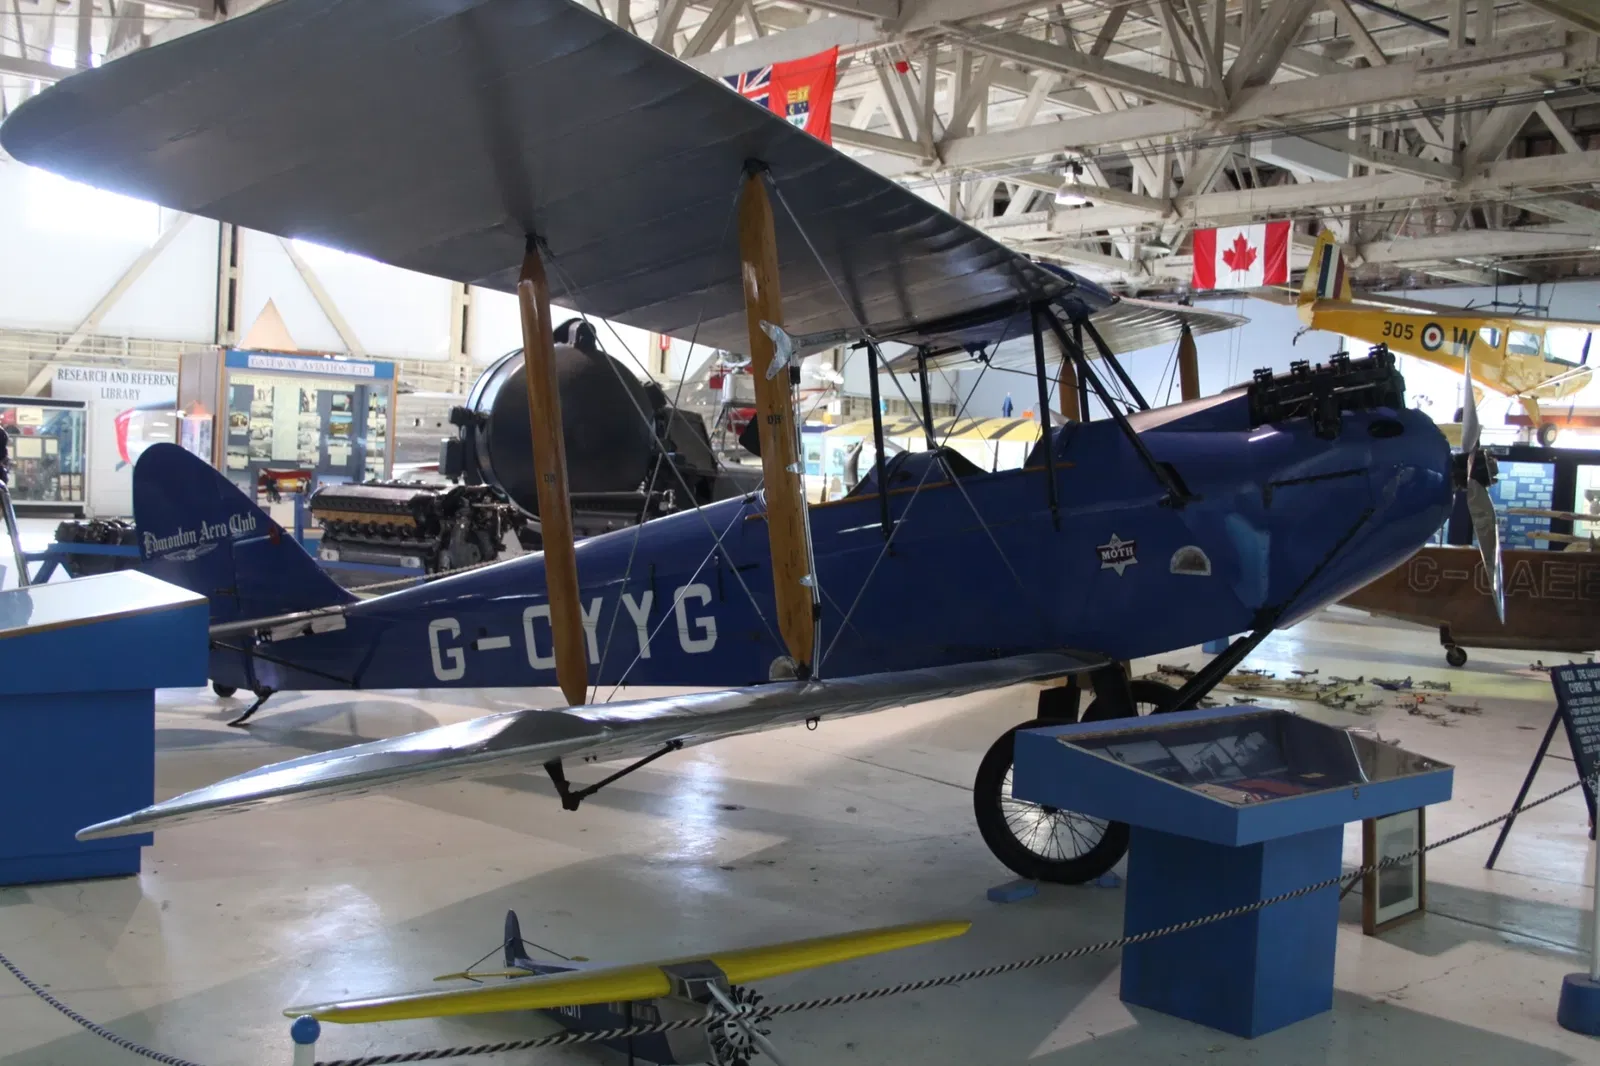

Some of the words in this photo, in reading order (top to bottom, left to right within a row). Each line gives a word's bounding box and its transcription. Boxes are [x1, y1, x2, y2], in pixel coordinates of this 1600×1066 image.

[1383, 320, 1414, 340] 305
[251, 358, 297, 369] GATEWAY
[302, 361, 347, 372] AVIATION
[57, 368, 107, 383] RESEARCH
[110, 371, 129, 384] AND
[101, 387, 141, 400] LIBRARY
[143, 527, 197, 559] Edmonton
[200, 520, 228, 541] Aero
[229, 511, 257, 536] Club
[1101, 546, 1133, 560] MOTH
